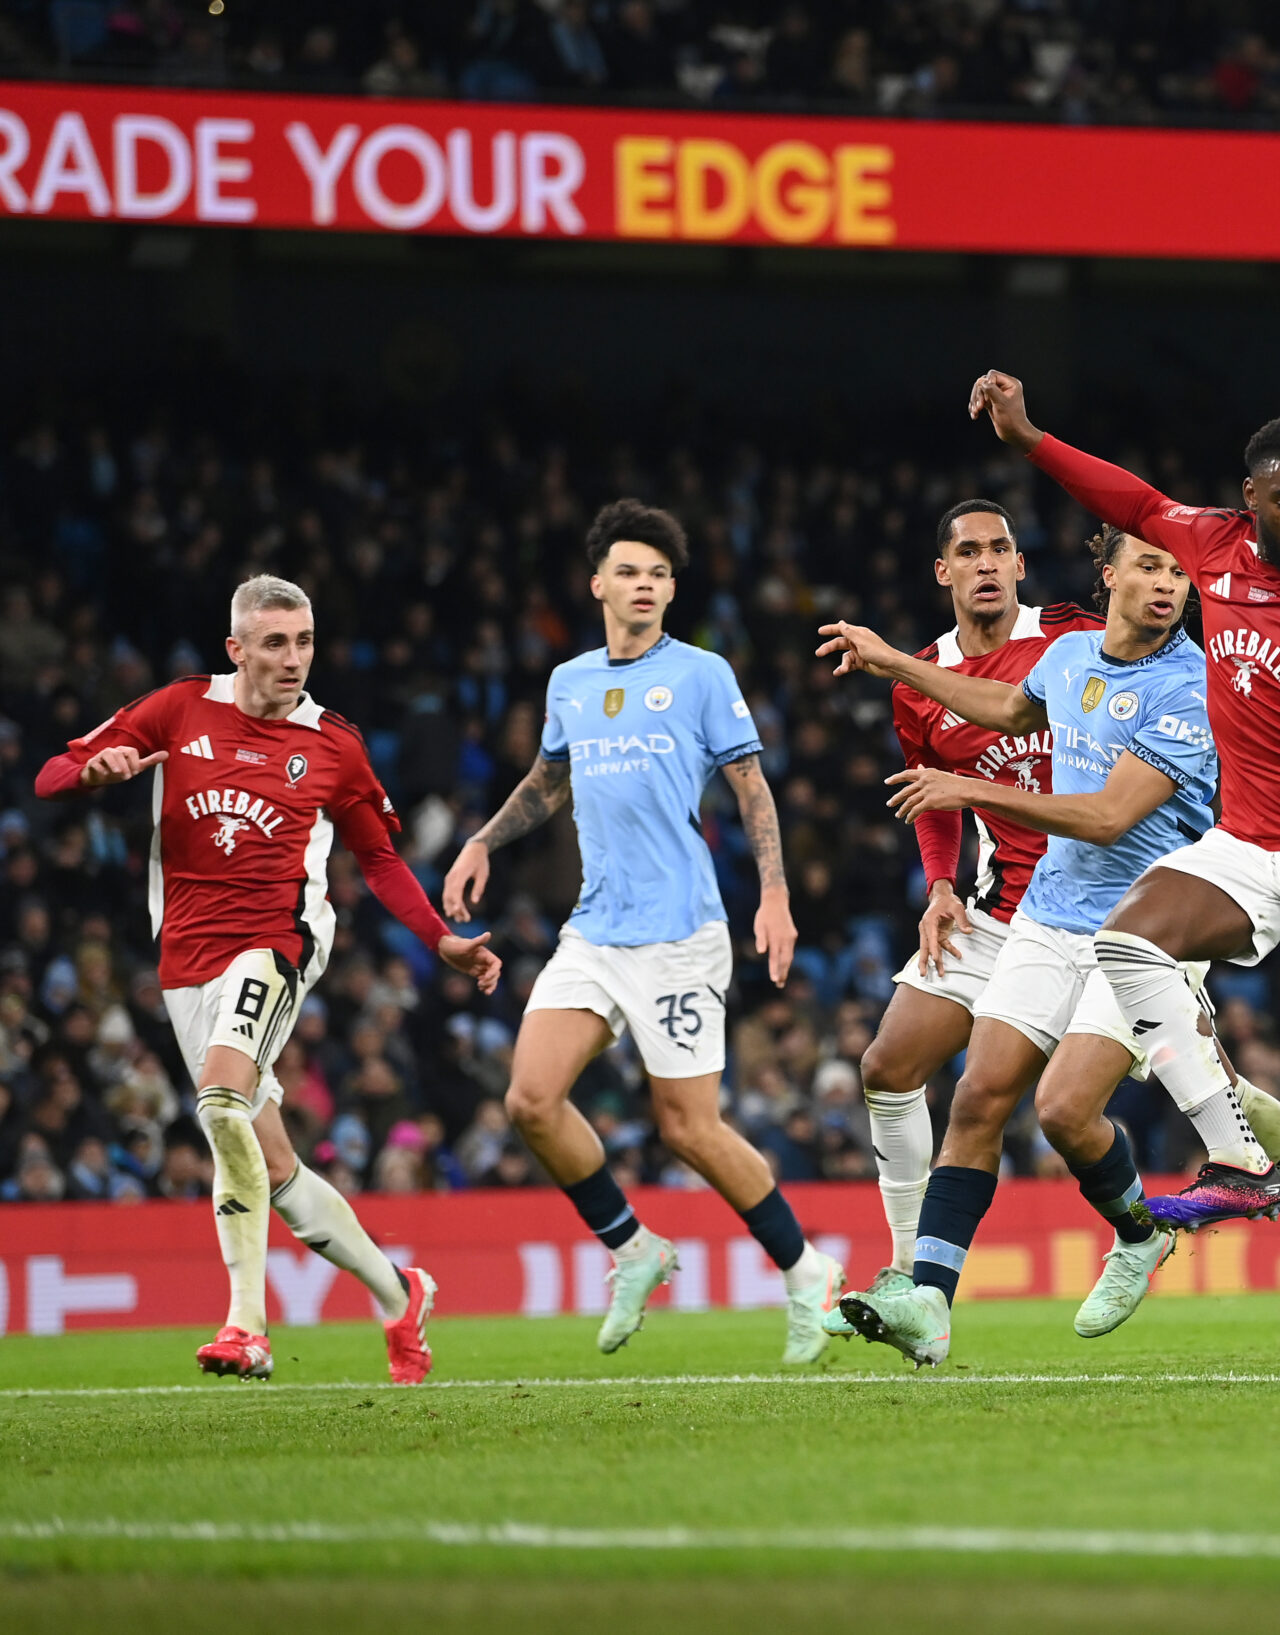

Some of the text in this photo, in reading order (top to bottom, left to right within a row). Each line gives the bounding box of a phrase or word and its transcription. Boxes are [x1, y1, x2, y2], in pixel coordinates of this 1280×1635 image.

[285, 122, 587, 235] YOUR
[614, 135, 897, 248] EDGE
[569, 734, 675, 762] ETIHAD
[583, 758, 649, 777] AIRWAYS
[975, 730, 1052, 780] FIREBAL
[185, 789, 284, 838] FIREBALL
[234, 977, 270, 1022] 8
[655, 991, 702, 1038] 75
